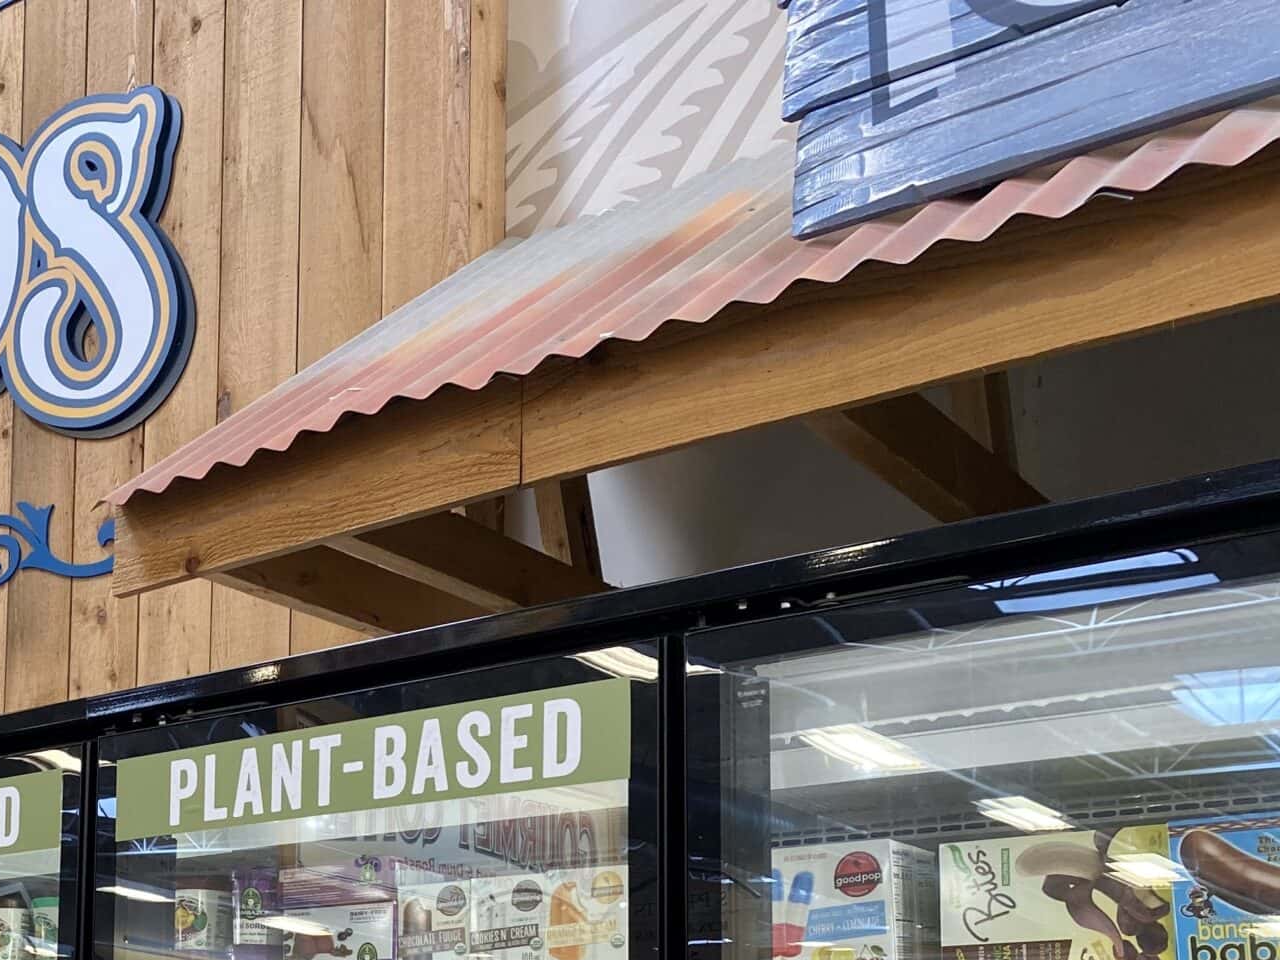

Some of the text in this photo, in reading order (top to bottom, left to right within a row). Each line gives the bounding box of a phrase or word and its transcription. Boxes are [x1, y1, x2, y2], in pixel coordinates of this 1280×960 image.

[169, 697, 584, 826] PLANT-BASED
[835, 871, 881, 887] goodpop
[963, 850, 1016, 942] Bites
